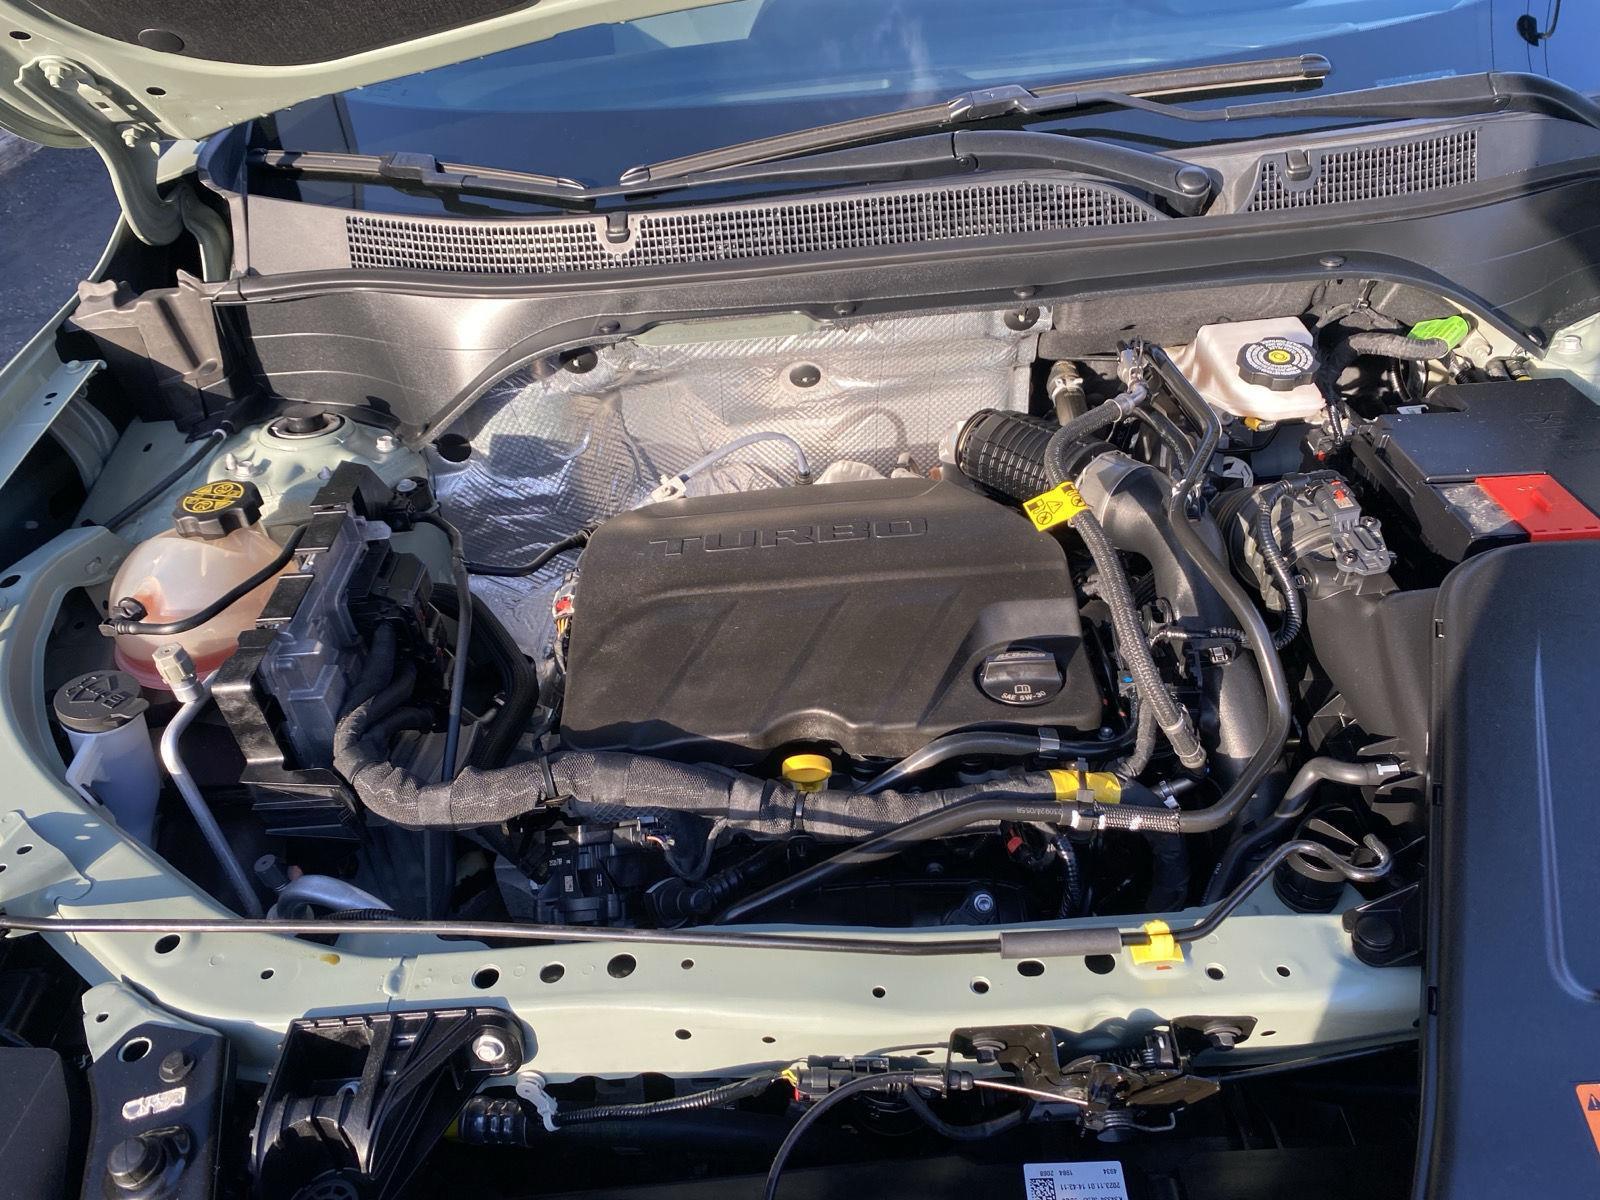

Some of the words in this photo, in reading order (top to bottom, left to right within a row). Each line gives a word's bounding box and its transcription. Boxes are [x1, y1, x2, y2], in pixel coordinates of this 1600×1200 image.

[648, 518, 928, 556] TURBO
[1001, 692, 1017, 701] SAE
[1019, 690, 1046, 701] 5W-30
